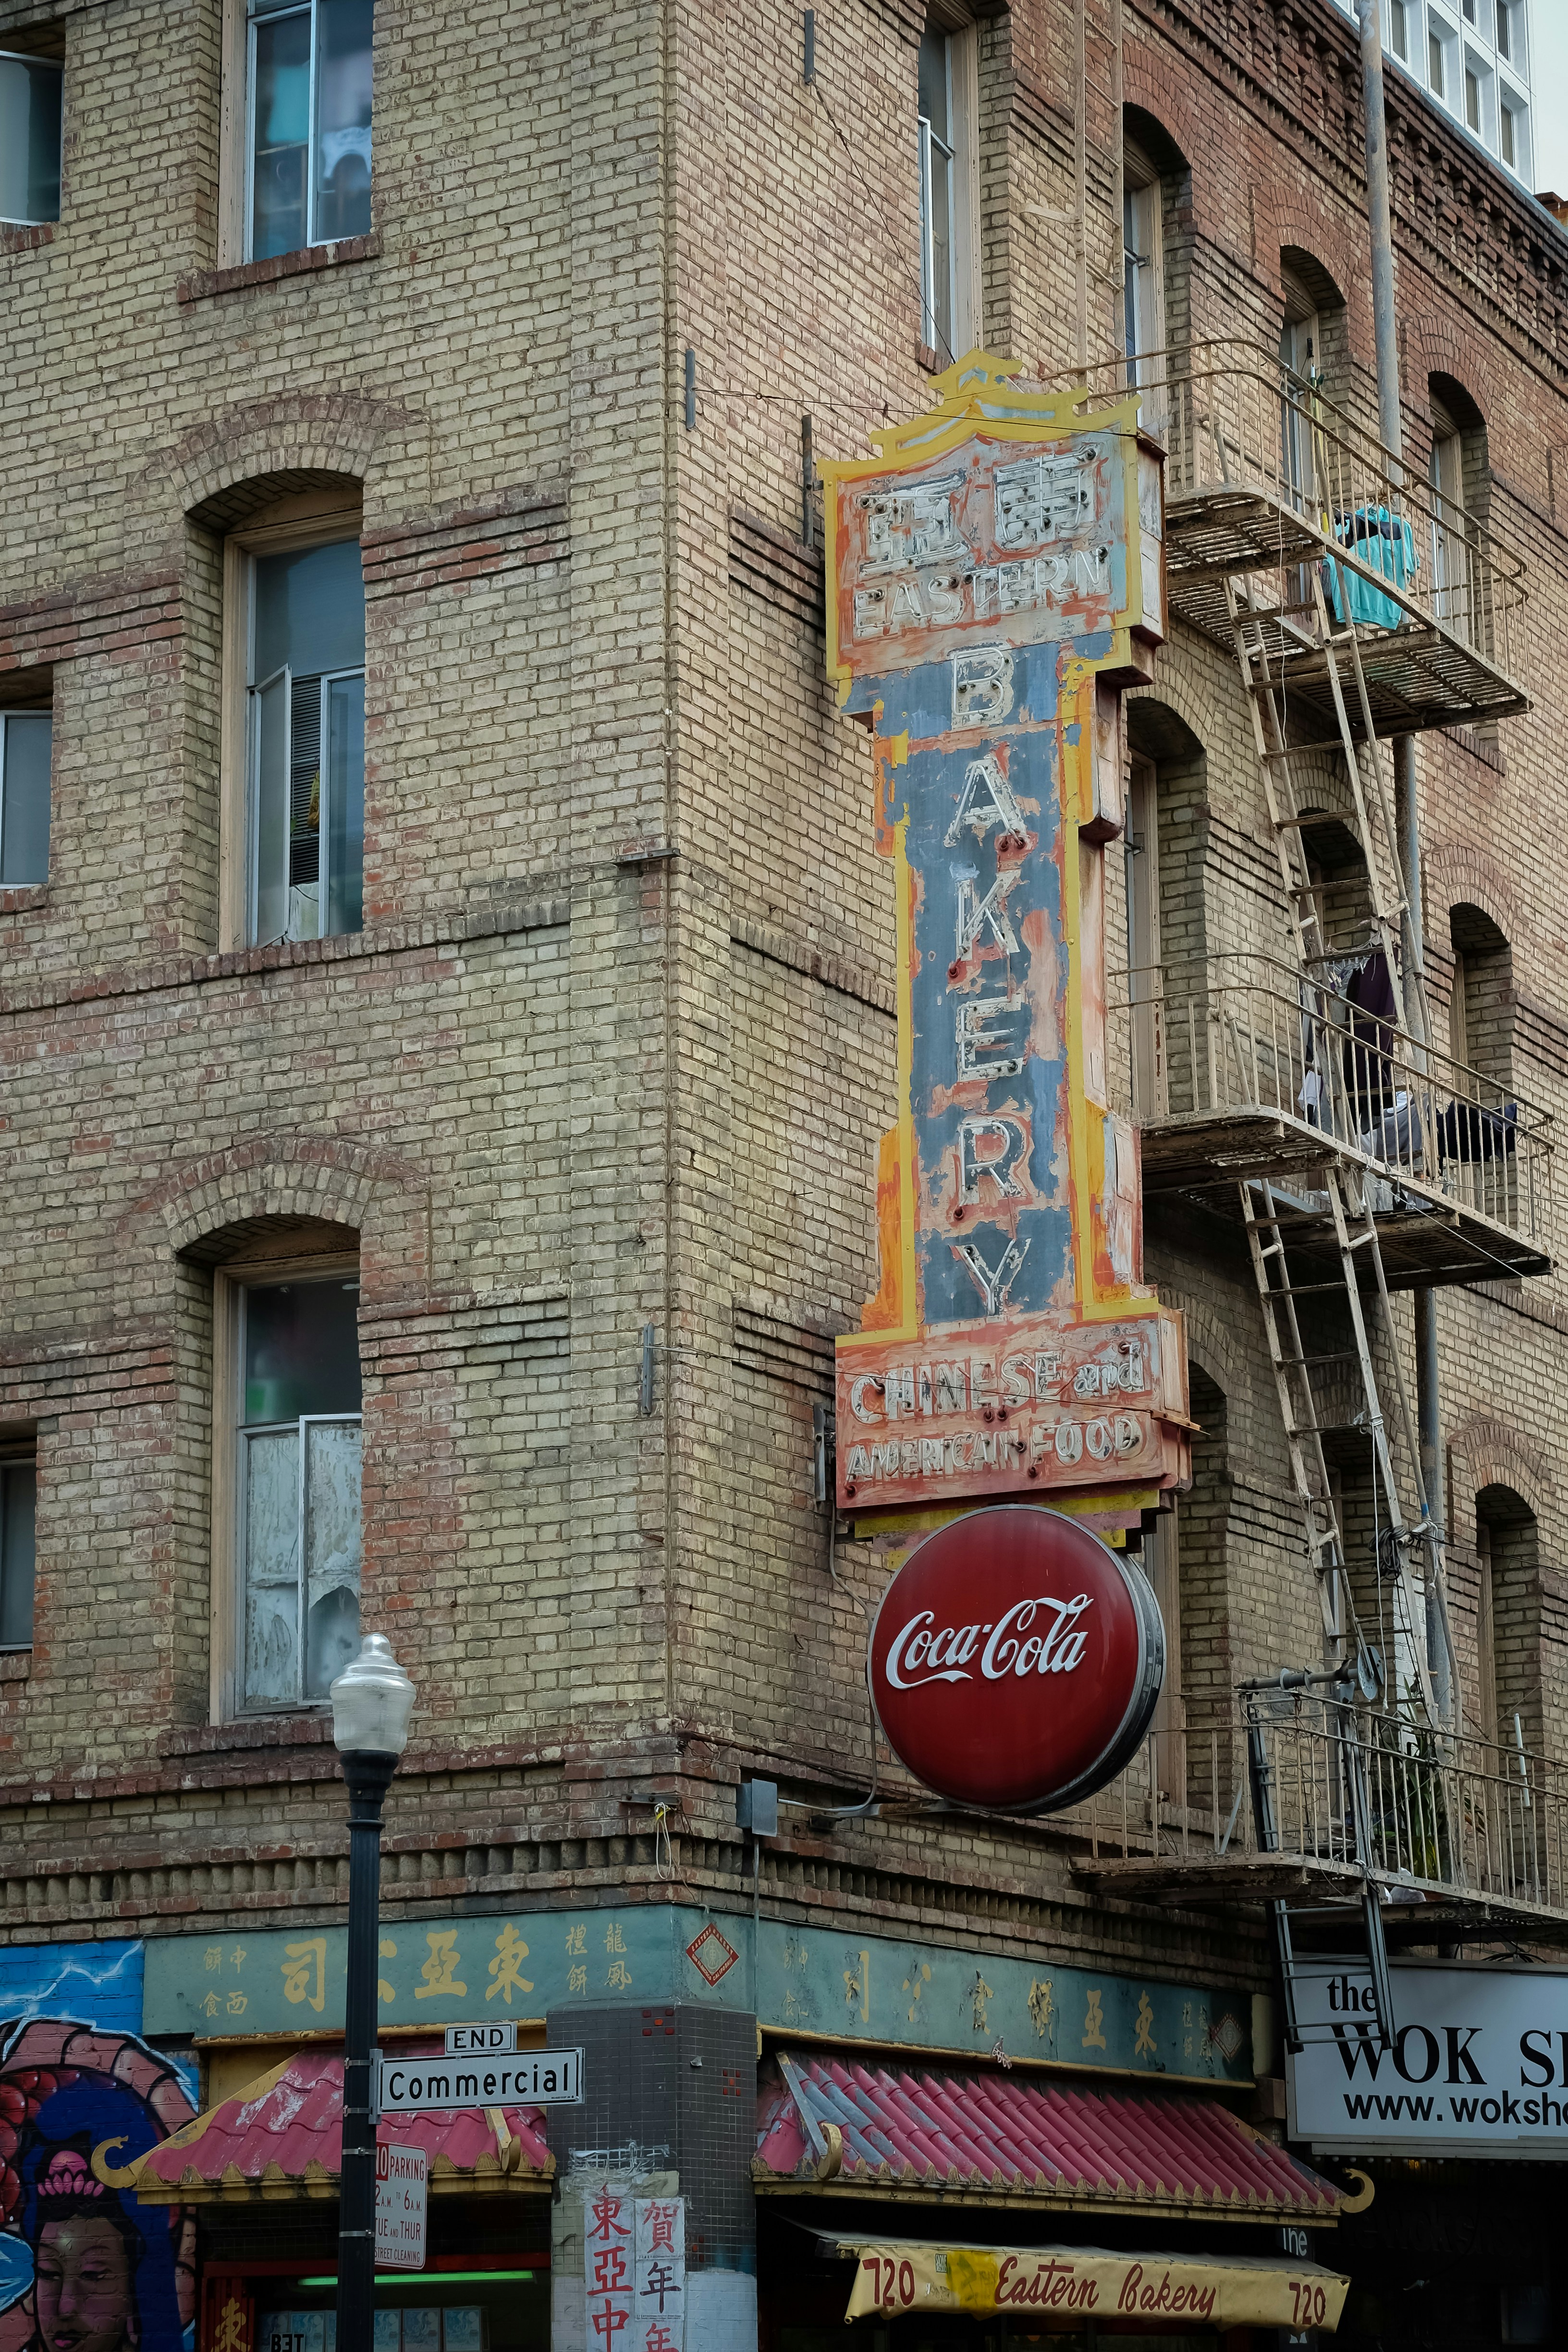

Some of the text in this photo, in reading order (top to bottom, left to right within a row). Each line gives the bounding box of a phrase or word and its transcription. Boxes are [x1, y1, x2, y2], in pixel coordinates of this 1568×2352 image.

[854, 547, 1110, 638] EASTERN
[943, 646, 1032, 1315] BAKERY
[850, 1339, 1146, 1423] CHINESE and
[846, 1415, 1144, 1482] AMERICAN FOOD
[886, 1593, 1093, 1690] Coca-Cola
[1326, 1976, 1377, 2012] the
[454, 2028, 504, 2049] END
[1331, 2023, 1568, 2088] WOK S
[389, 2063, 568, 2100] Commercial
[390, 2155, 425, 2181] PARKING
[396, 2191, 401, 2200] TO
[375, 2246, 420, 2263] STREET CLEANING
[390, 2228, 399, 2238] AND
[400, 2220, 421, 2241] THUR
[862, 2256, 1326, 2326] 720 Eastern Bakery 720
